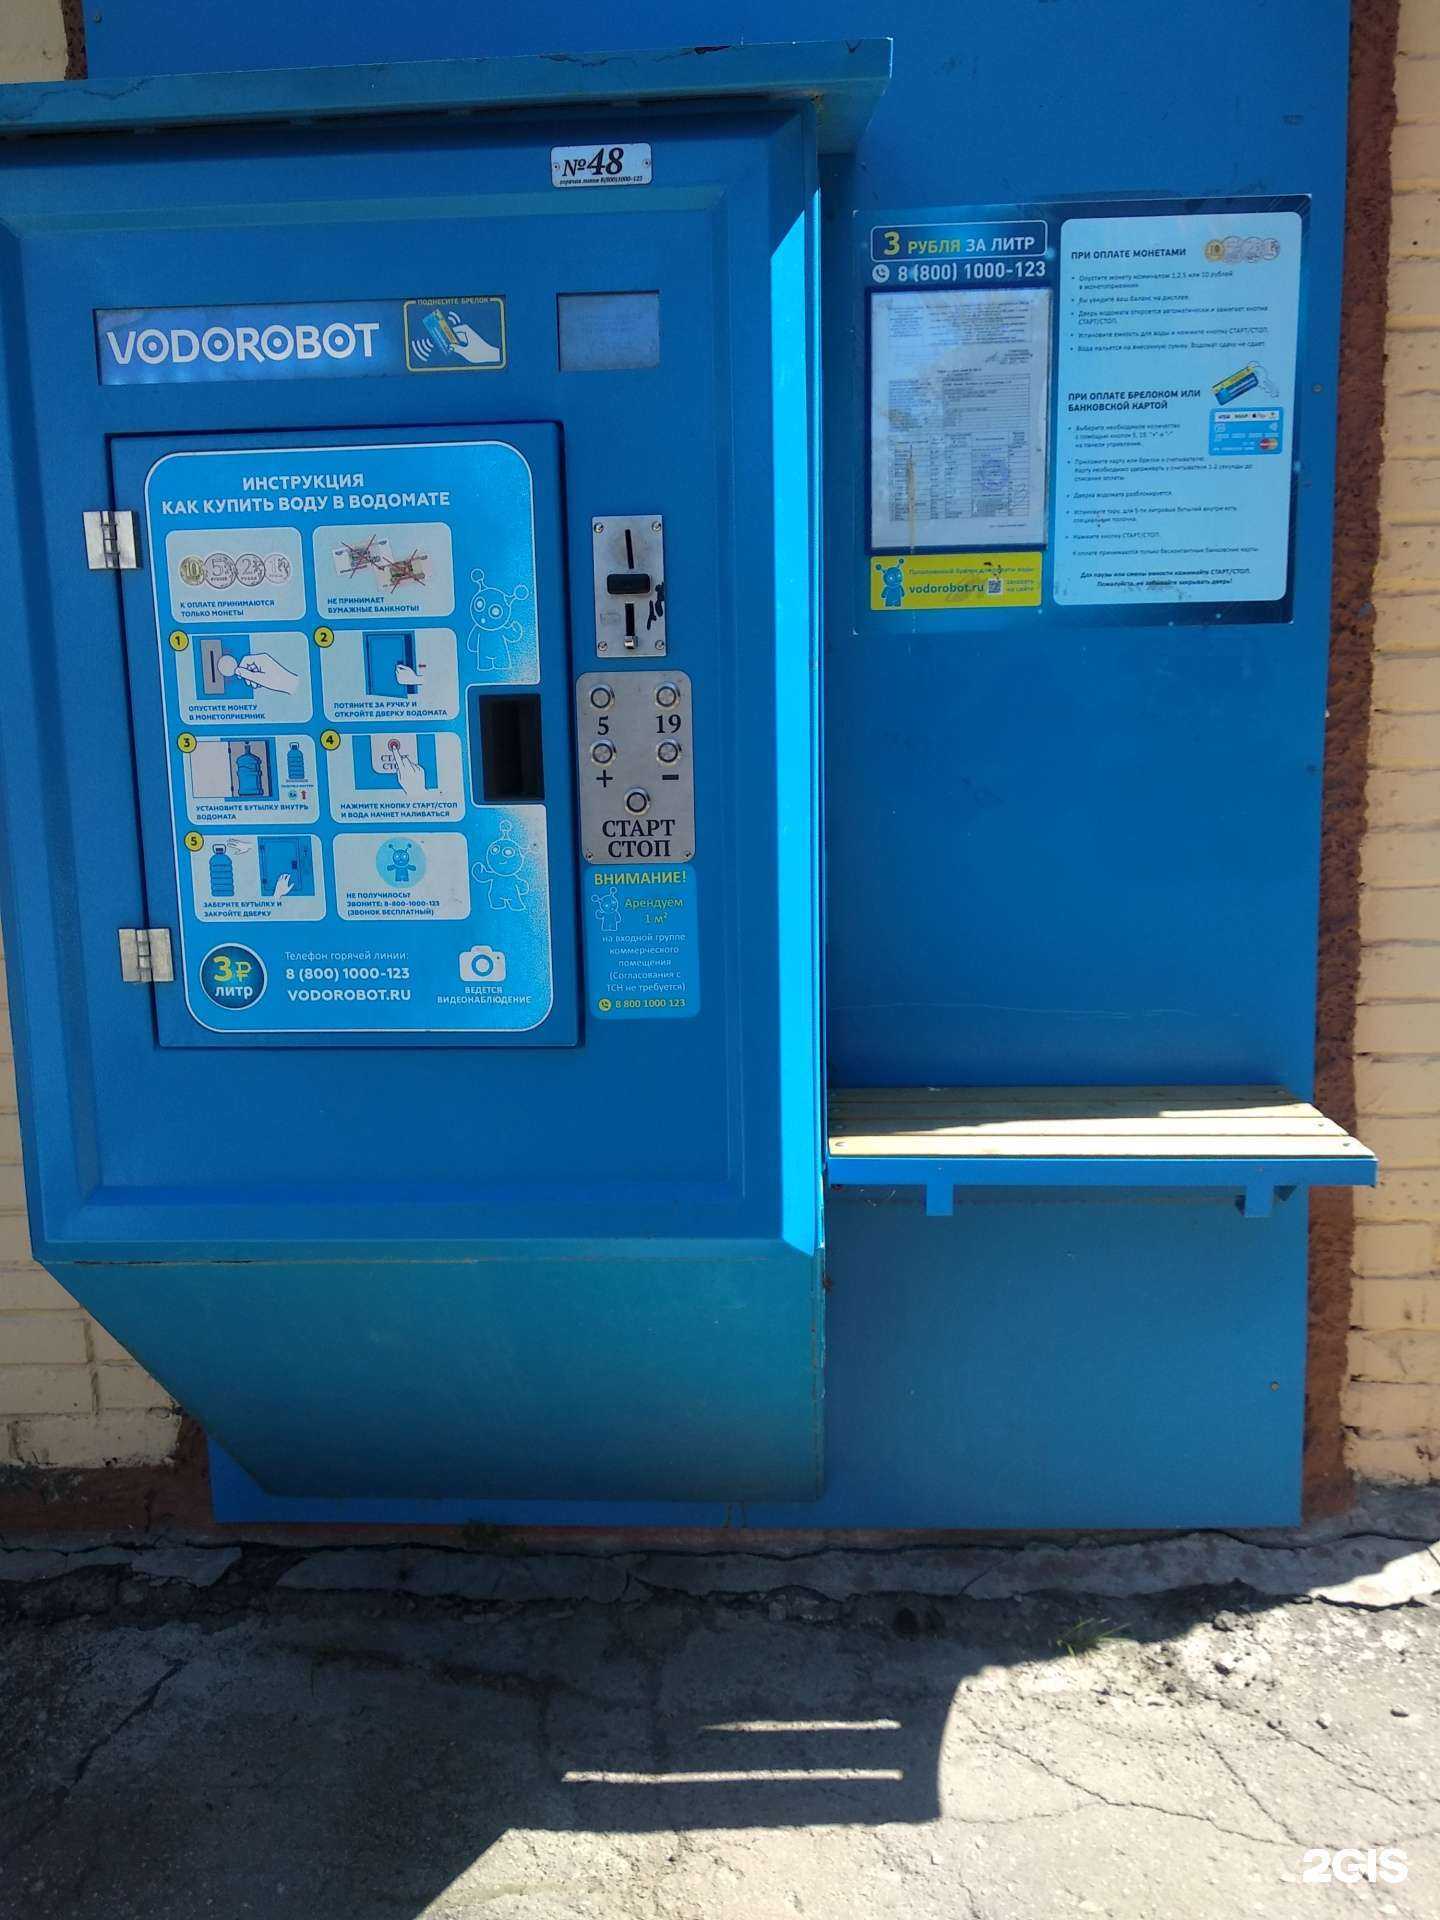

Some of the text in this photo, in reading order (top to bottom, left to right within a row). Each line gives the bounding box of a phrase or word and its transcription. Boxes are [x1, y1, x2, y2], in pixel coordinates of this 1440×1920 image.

[562, 147, 624, 177] №48
[884, 231, 1035, 256] 3 РУБЛЯ ЗА ЛИТР
[1071, 248, 1187, 260] ПРИ ОПЛАТЕ МОНЕТАМИ
[898, 261, 1046, 282] 8 (800) 1000-123
[107, 322, 380, 364] VODOROBOT
[1068, 389, 1201, 401] ПРИ ОПЛАТЕ БРЕЛОКОМ ИЛИ
[1068, 400, 1168, 412] БАНКОВСКОЙ КАРТОЙ
[242, 473, 364, 491] ИНСТРУКЦИЯ
[162, 492, 450, 515] КАК КУПИТЬ ВОДУ В ВОДОМАТЕ
[211, 559, 224, 577] 5
[242, 559, 252, 576] 2
[909, 583, 984, 594] vodorobot.ru
[217, 599, 275, 607] ПРИНИМАЮТСЯ
[328, 606, 373, 614] БУМАЖНЫЕ
[175, 636, 182, 646] 1
[320, 632, 328, 642] 2
[188, 703, 258, 712] ОПУСТИТЕ МОНЕТУ
[386, 701, 410, 709] РУЧКУ
[334, 709, 448, 718] ОТКРОЙТЕ ДВЕРКУ ВОДОМАТА
[598, 716, 609, 736] 5
[656, 714, 682, 734] 19
[184, 737, 190, 747] 3
[326, 735, 334, 745] 4
[196, 803, 309, 812] УСТАНОВИТЕ БУТЫЛКУ ВНУТРЬ
[380, 802, 410, 810] КНОПКУ
[401, 810, 450, 818] НАЛИВАТЬСЯ
[602, 819, 676, 838] СТАРТ
[190, 836, 197, 847] 5
[607, 839, 671, 858] СТОП
[594, 870, 687, 885] ВНИМАНИЕ!
[241, 900, 275, 908] БУТЫЛКУ
[347, 900, 440, 908] ЗВОНИТЕ: 8-800-1000-123
[624, 897, 683, 909] Арендуем
[204, 909, 272, 918] ЗАКРОЙТЕ ДВЕРКУ
[347, 908, 435, 917] (ЗВОНОК БЕСПЛАТНЫЙ)
[645, 914, 651, 923] 1
[615, 933, 653, 944] входной
[655, 934, 686, 944] группе
[285, 950, 409, 962] Телефон горячей линии:
[609, 946, 680, 956] коммерческого
[618, 959, 672, 969] помещения
[286, 967, 410, 982] 8 (800) 1000-123
[609, 971, 675, 981] (Согласования
[214, 986, 254, 1000] литр
[465, 985, 503, 995] ВЕДЕТСЯ
[639, 983, 686, 993] требуется)
[287, 989, 411, 1002] VODOROBOT.RU
[437, 995, 532, 1006] ВИДЕОНАБЛЮДЕНИЕ
[615, 998, 685, 1008] 8 800 1000 123
